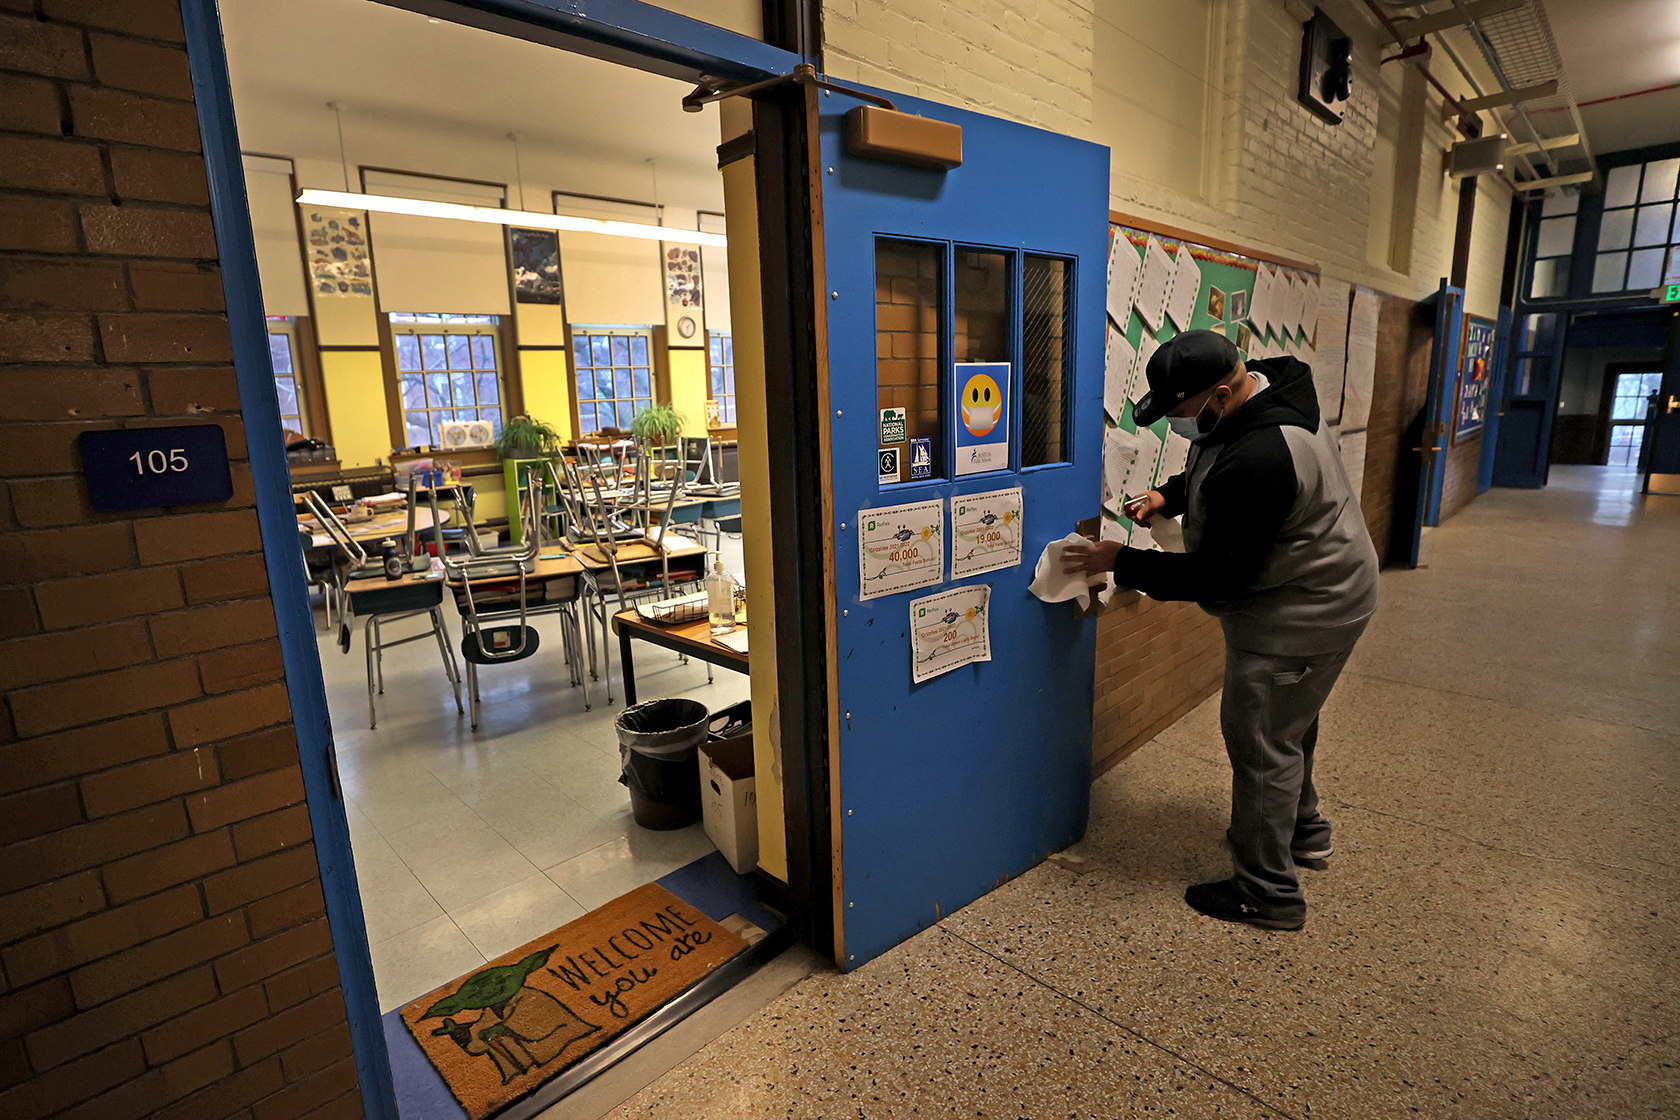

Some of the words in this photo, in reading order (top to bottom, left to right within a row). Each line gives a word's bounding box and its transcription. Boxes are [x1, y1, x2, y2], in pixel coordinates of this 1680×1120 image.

[883, 427, 904, 435] PARKS
[129, 449, 189, 475] 105
[913, 466, 931, 475] SEA
[976, 531, 1001, 544] 19,000
[889, 547, 919, 562] 40,000
[921, 630, 938, 638] Grizzlies
[943, 630, 957, 642] 200
[546, 905, 696, 991] WELCOME
[589, 967, 657, 1018] you
[670, 930, 712, 961] are
